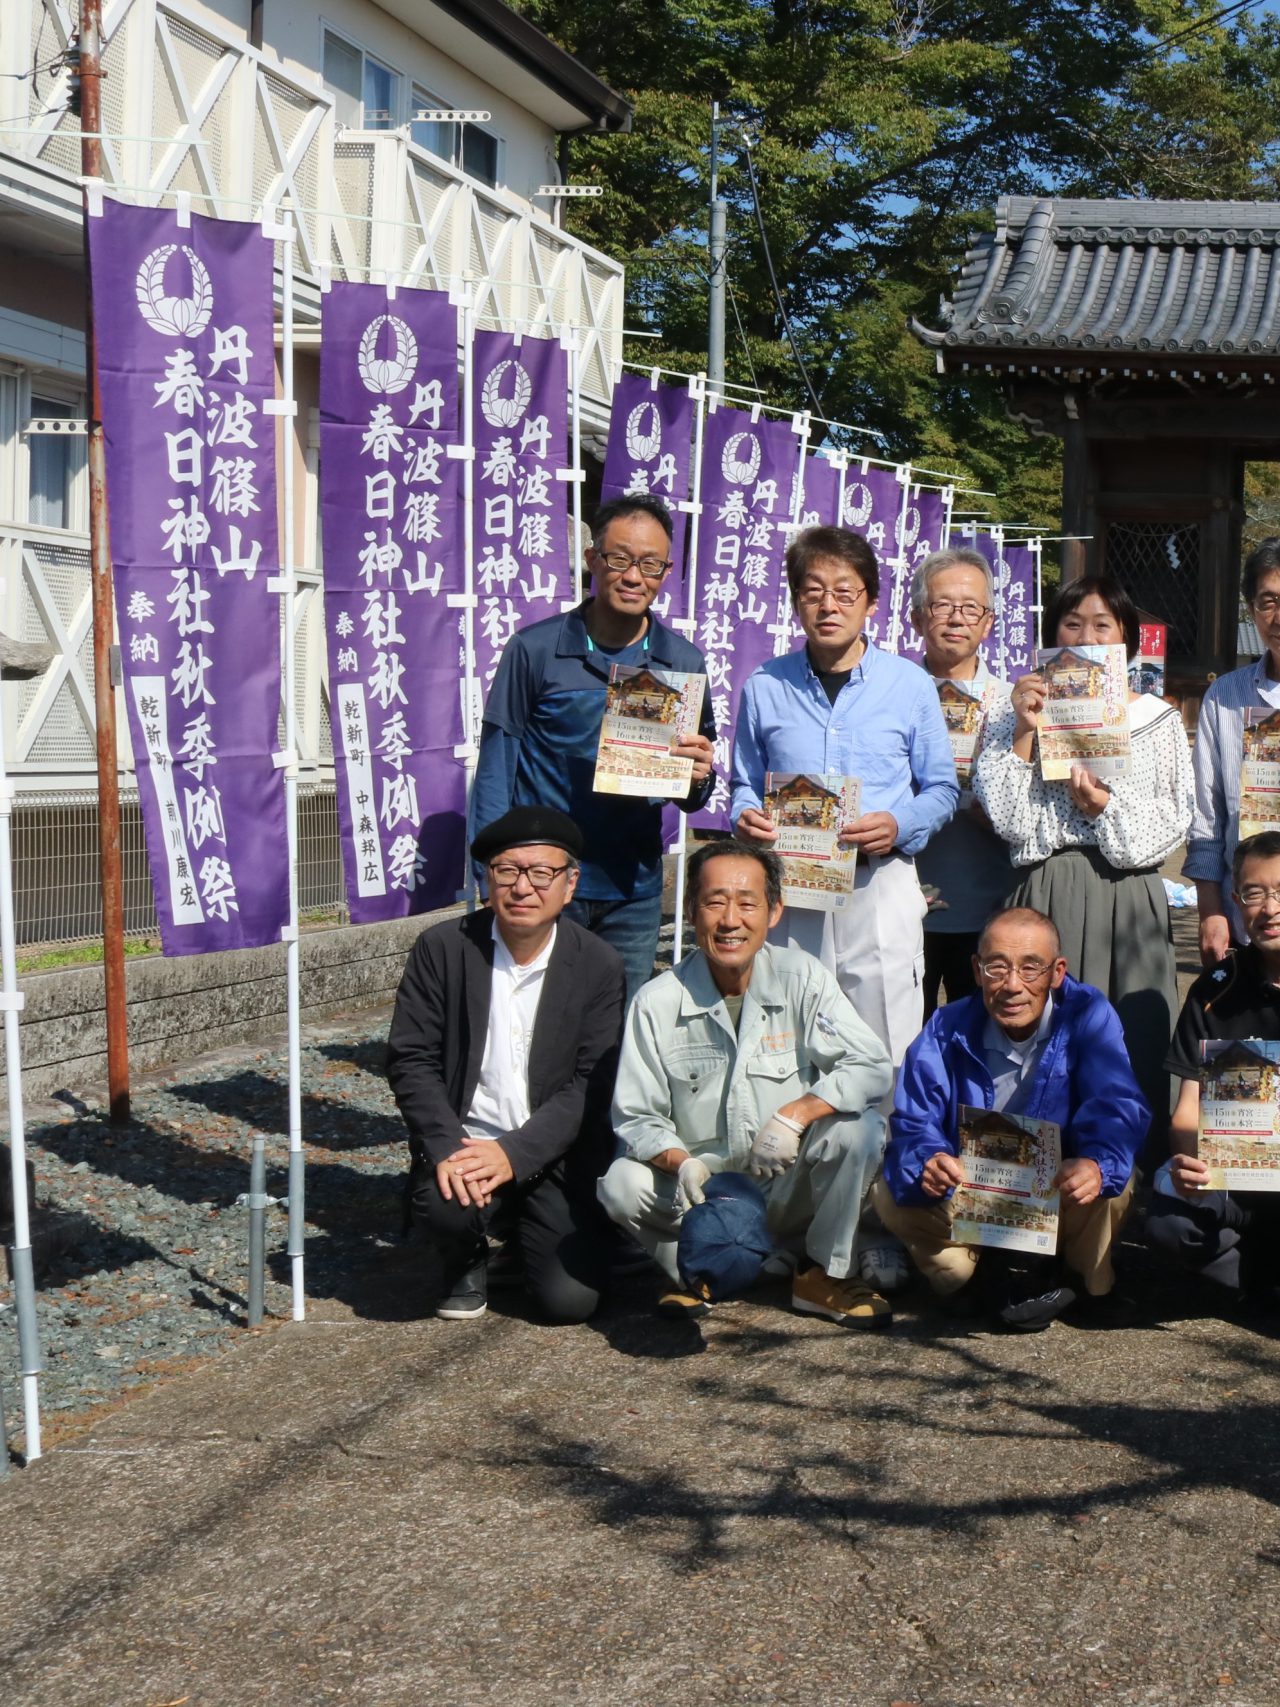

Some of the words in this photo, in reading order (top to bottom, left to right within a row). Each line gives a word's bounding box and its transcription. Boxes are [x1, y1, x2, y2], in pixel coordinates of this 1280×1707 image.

[207, 324, 262, 580] 丹波篠山
[402, 378, 445, 597] 丹波篠山
[517, 414, 558, 605] 丹波篠山
[126, 589, 160, 664] 奉納
[152, 347, 240, 921] 春日神社秋季例祭
[335, 611, 359, 673] 奉納
[737, 479, 779, 625] 丹波篠山
[1007, 581, 1028, 667] 丹波篠山
[140, 695, 167, 773] 乾新町
[358, 403, 428, 893] 春日神社秋季例祭
[344, 700, 365, 767] 乾新町
[355, 790, 380, 883] 中森邦広
